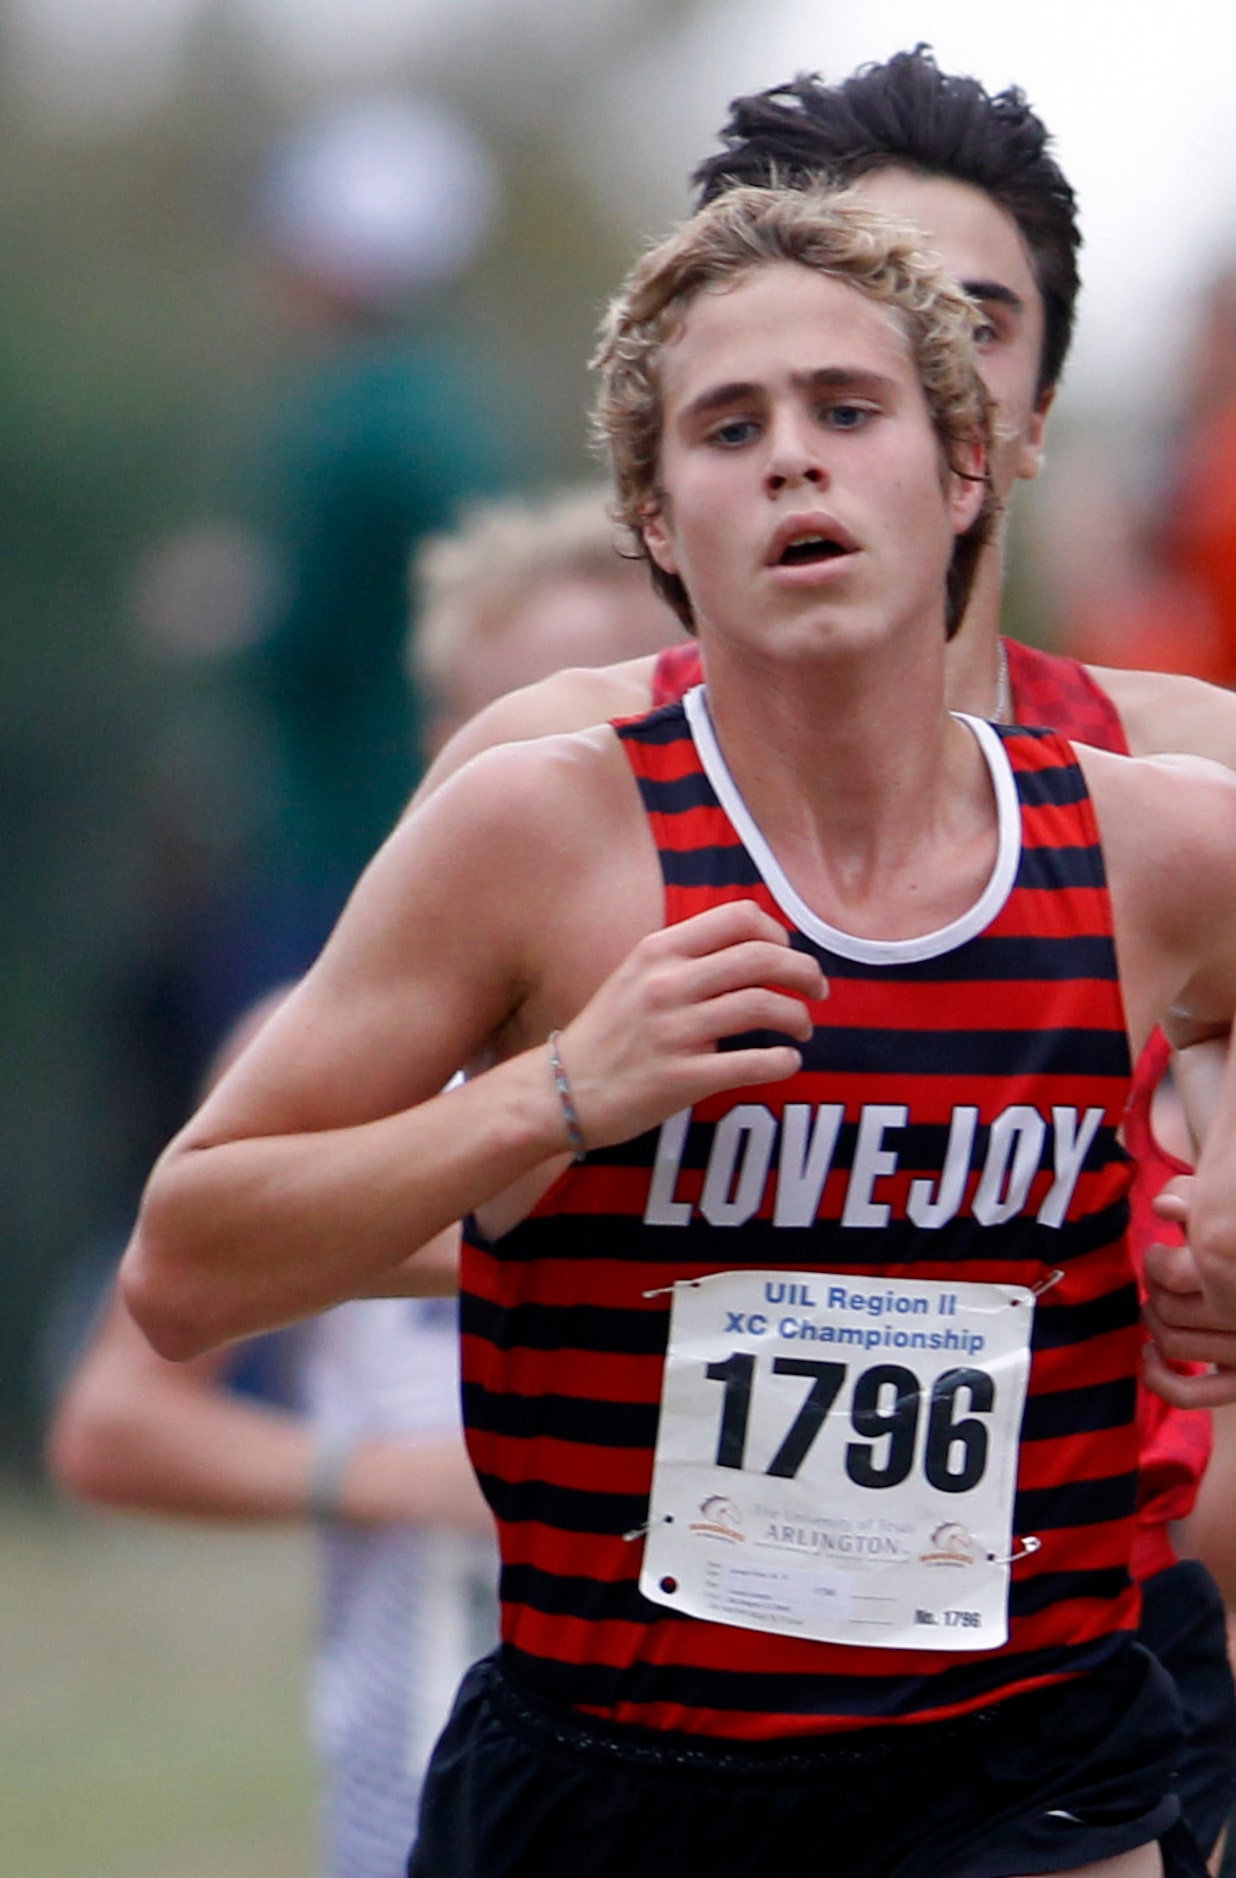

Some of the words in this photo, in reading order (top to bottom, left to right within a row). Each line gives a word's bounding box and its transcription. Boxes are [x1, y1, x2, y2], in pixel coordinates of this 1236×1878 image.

[643, 1103, 1106, 1229] LOVEJOY
[764, 1281, 816, 1307] UIL
[826, 1286, 929, 1316] Region
[938, 1293, 957, 1316] II
[724, 1310, 768, 1336] XC
[777, 1315, 986, 1354] Championship
[705, 1351, 996, 1494] 1796
[766, 1523, 899, 1555] ARLINGTON
[943, 1610, 982, 1629] 1796
